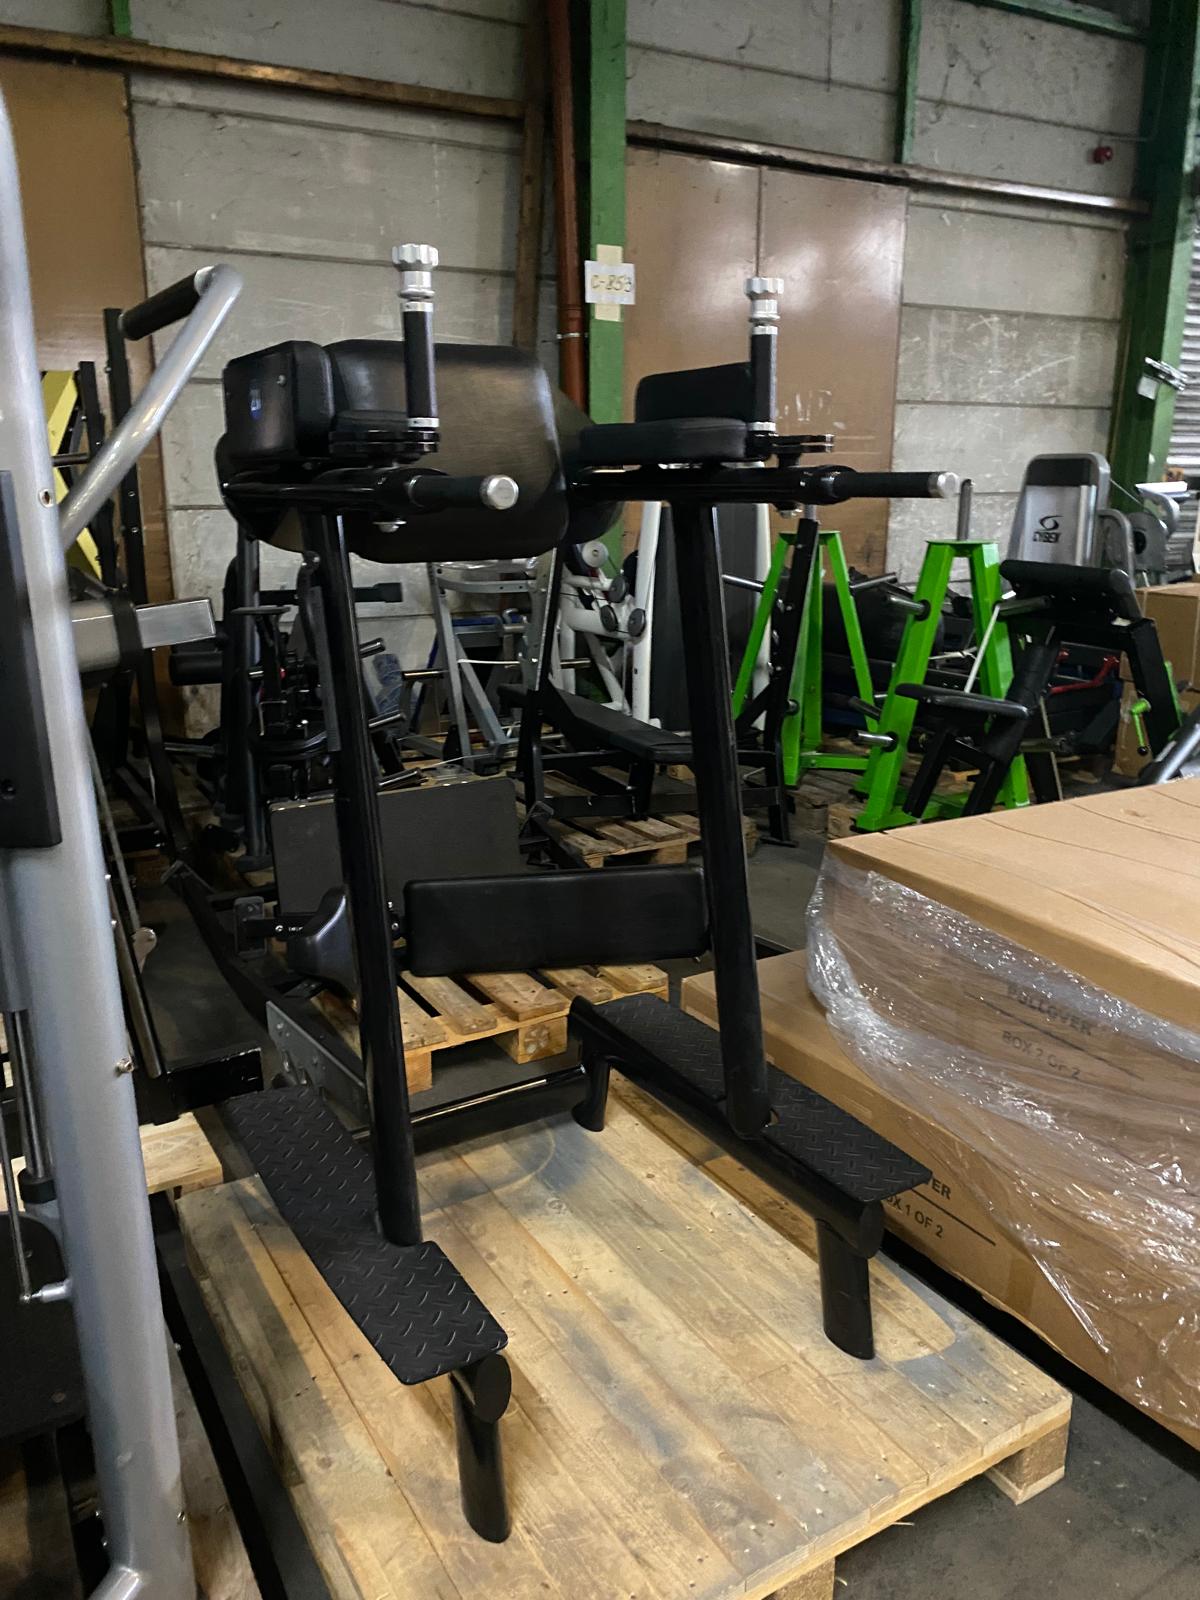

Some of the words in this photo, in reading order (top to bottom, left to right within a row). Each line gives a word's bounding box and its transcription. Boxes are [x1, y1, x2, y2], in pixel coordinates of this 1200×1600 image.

[1002, 1030, 1032, 1056] BOX
[1071, 1066, 1082, 1080] 2
[905, 1204, 912, 1217] 1
[914, 1210, 934, 1228] OF
[935, 1224, 944, 1239] 2
